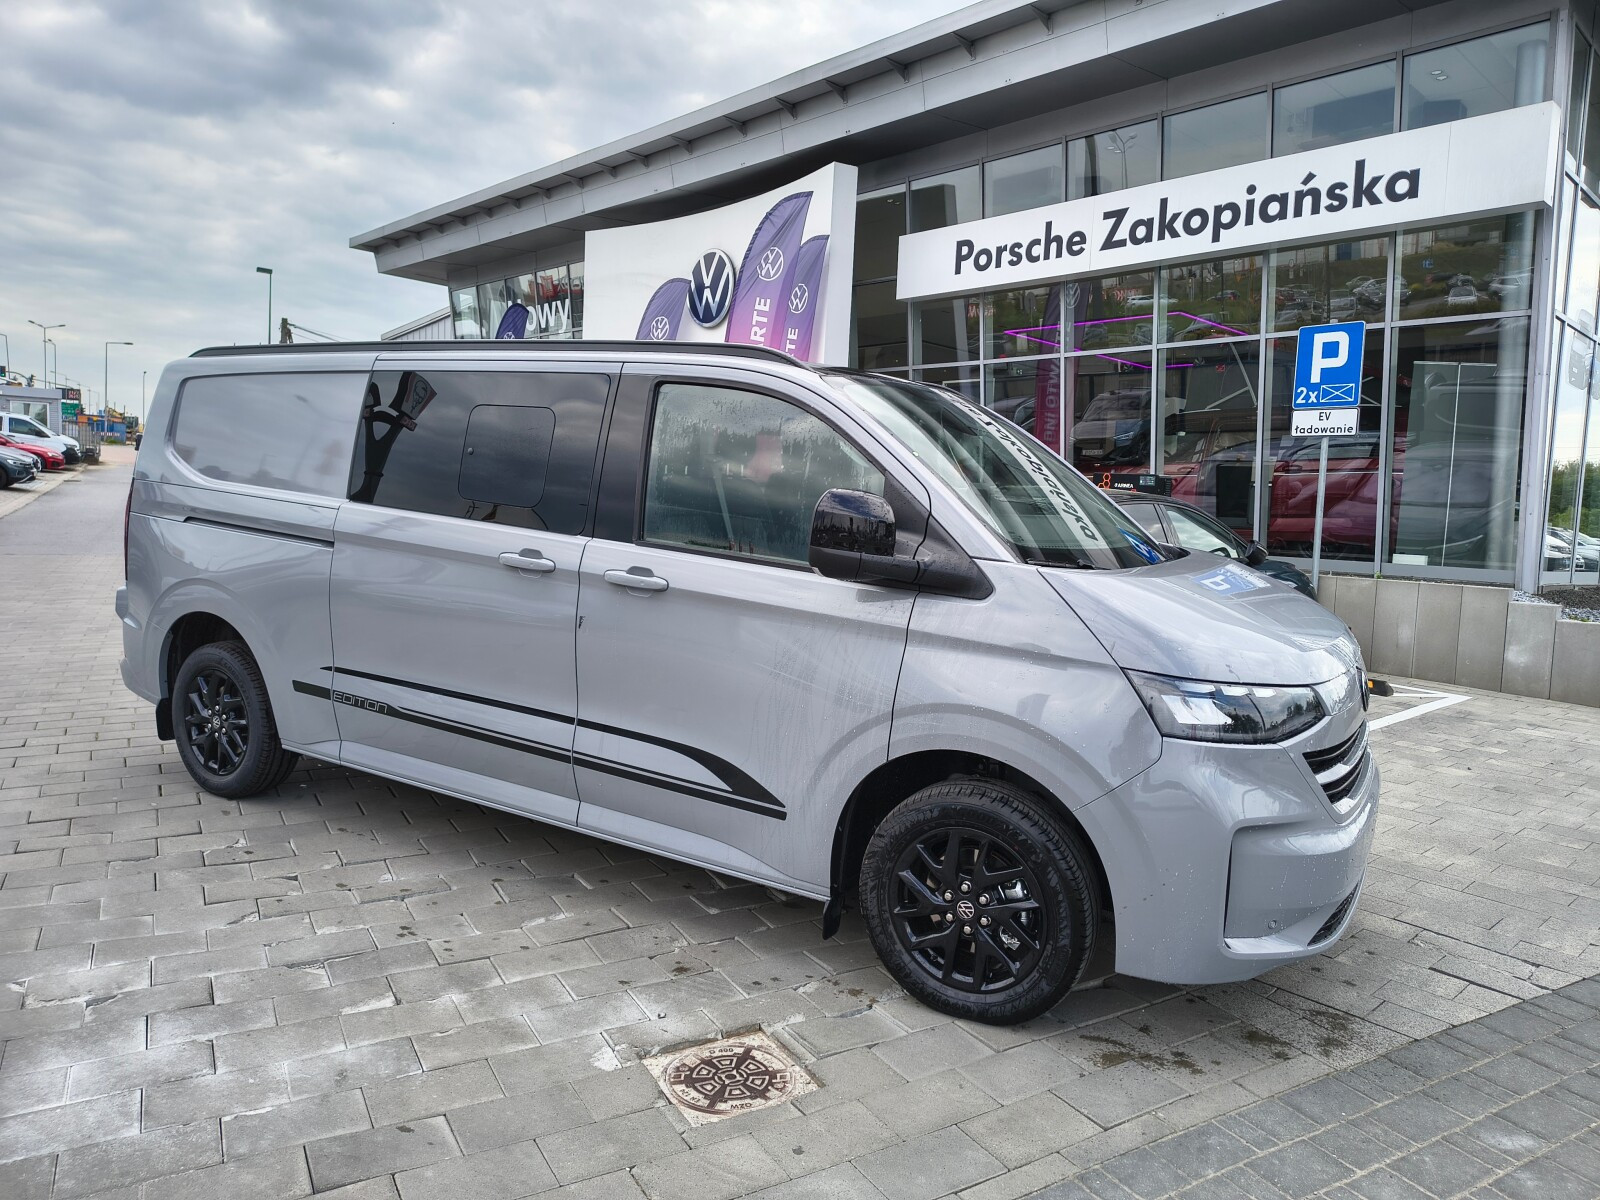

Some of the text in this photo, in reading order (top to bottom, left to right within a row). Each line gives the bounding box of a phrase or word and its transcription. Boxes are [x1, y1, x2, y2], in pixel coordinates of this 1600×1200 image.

[954, 158, 1421, 275] Porsche Zakopiańska
[508, 299, 569, 333] owy
[750, 297, 770, 346] RTE
[785, 328, 798, 356] TE
[1310, 331, 1350, 384] P
[1296, 386, 1319, 404] 2x
[1294, 423, 1354, 435] ładowanie
[1318, 411, 1332, 421] EV
